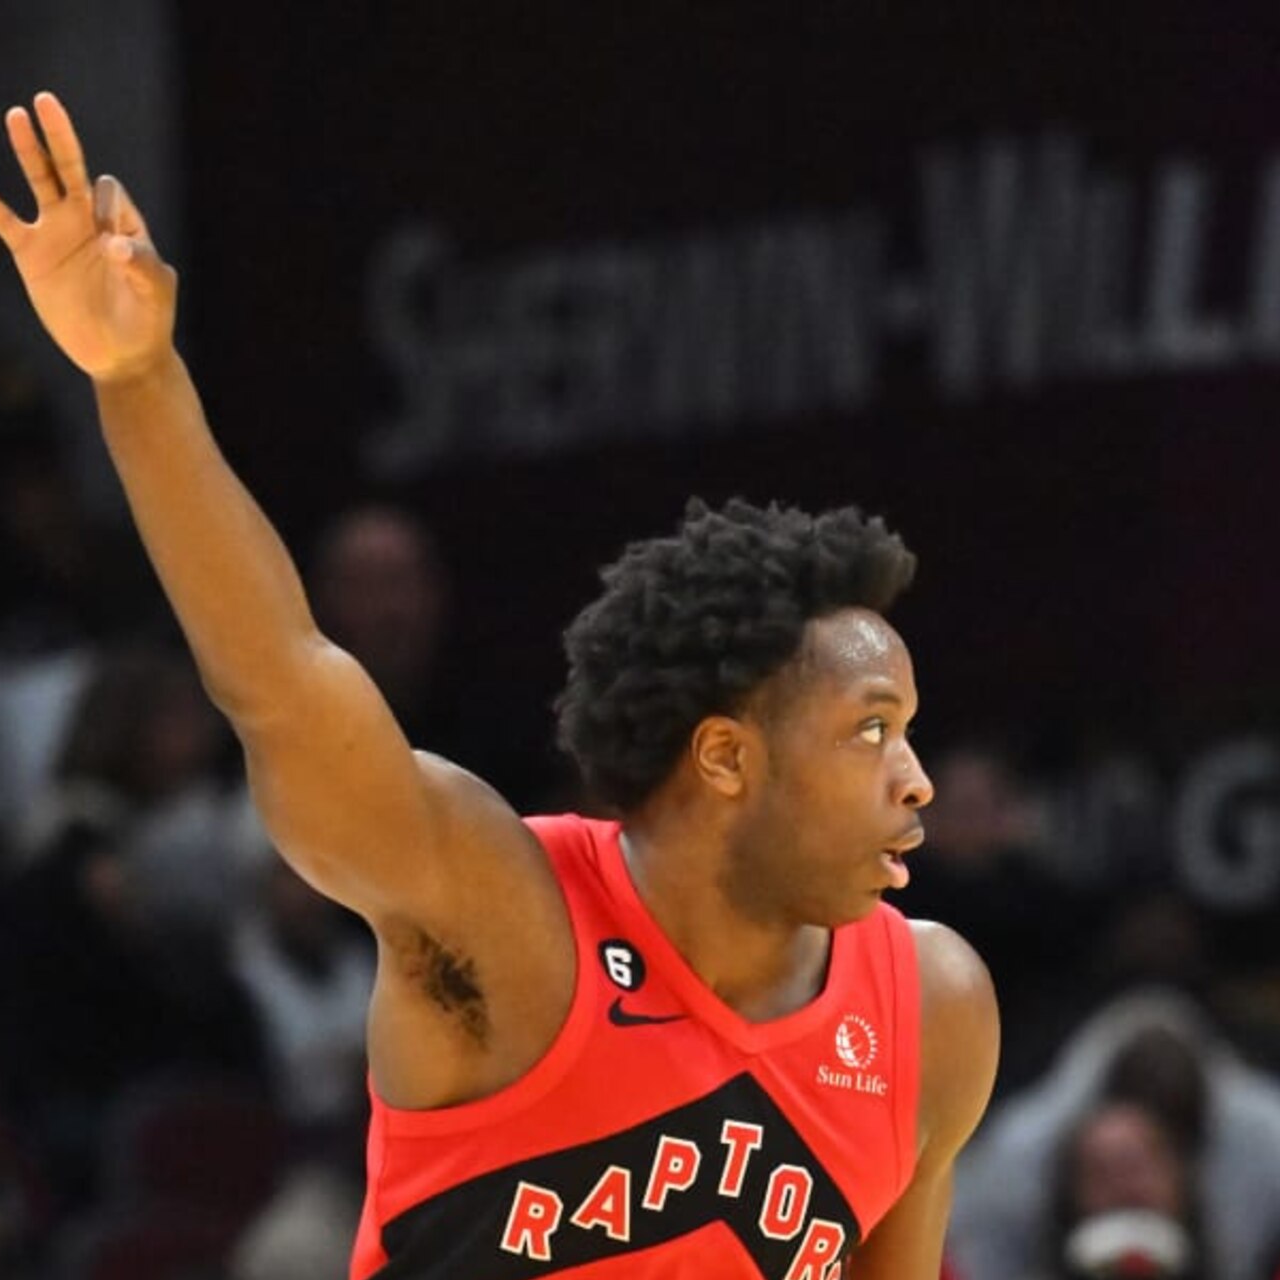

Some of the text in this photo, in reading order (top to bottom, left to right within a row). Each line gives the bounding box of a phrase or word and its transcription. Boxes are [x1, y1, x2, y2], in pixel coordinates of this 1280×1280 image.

[605, 946, 632, 988] 6
[816, 1064, 888, 1097] Sun Life
